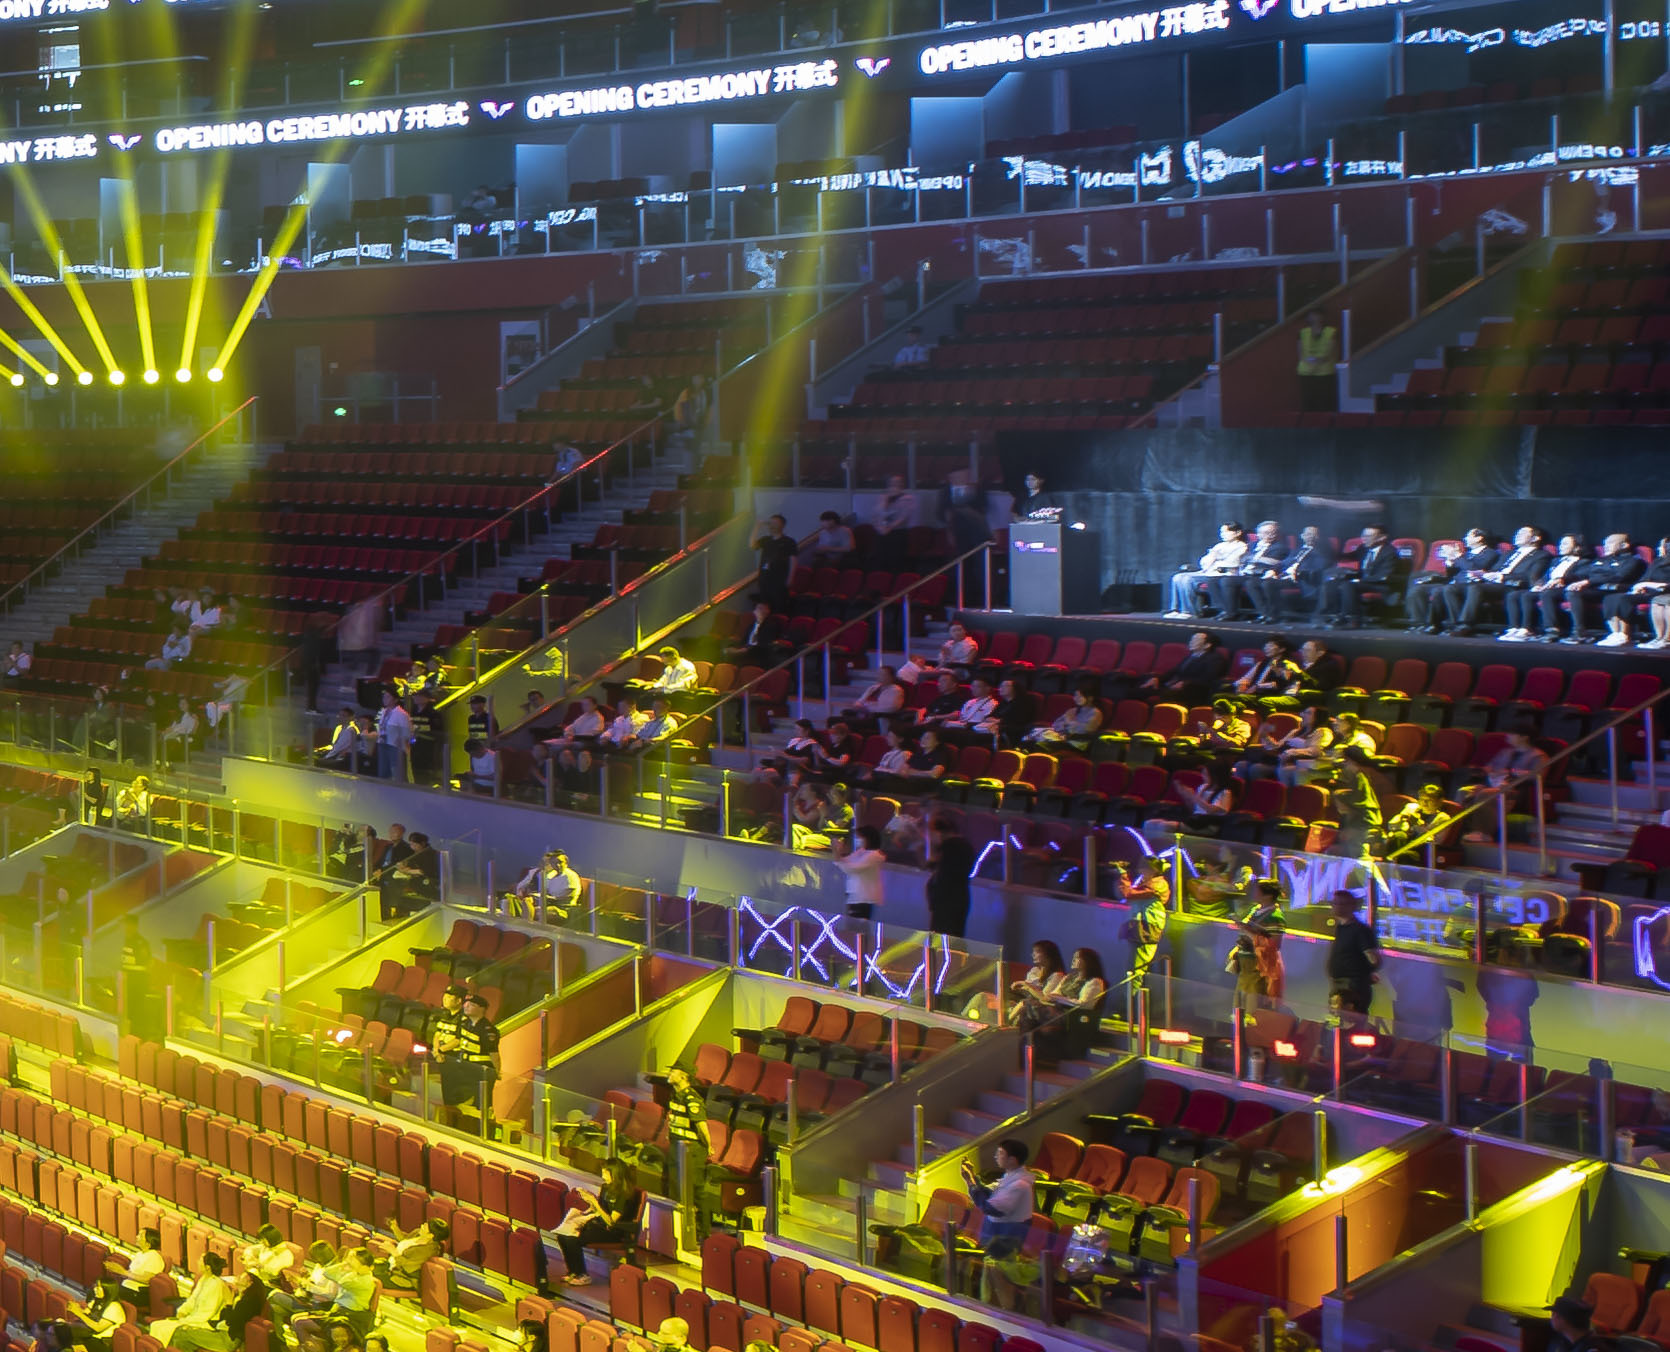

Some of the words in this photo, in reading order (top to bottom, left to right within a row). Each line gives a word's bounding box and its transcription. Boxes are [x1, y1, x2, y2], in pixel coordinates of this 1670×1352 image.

[920, 34, 1024, 74] OPENING
[1024, 11, 1160, 59] CEREMONY
[526, 86, 635, 120] OPENING
[636, 68, 772, 109] CEREMONY
